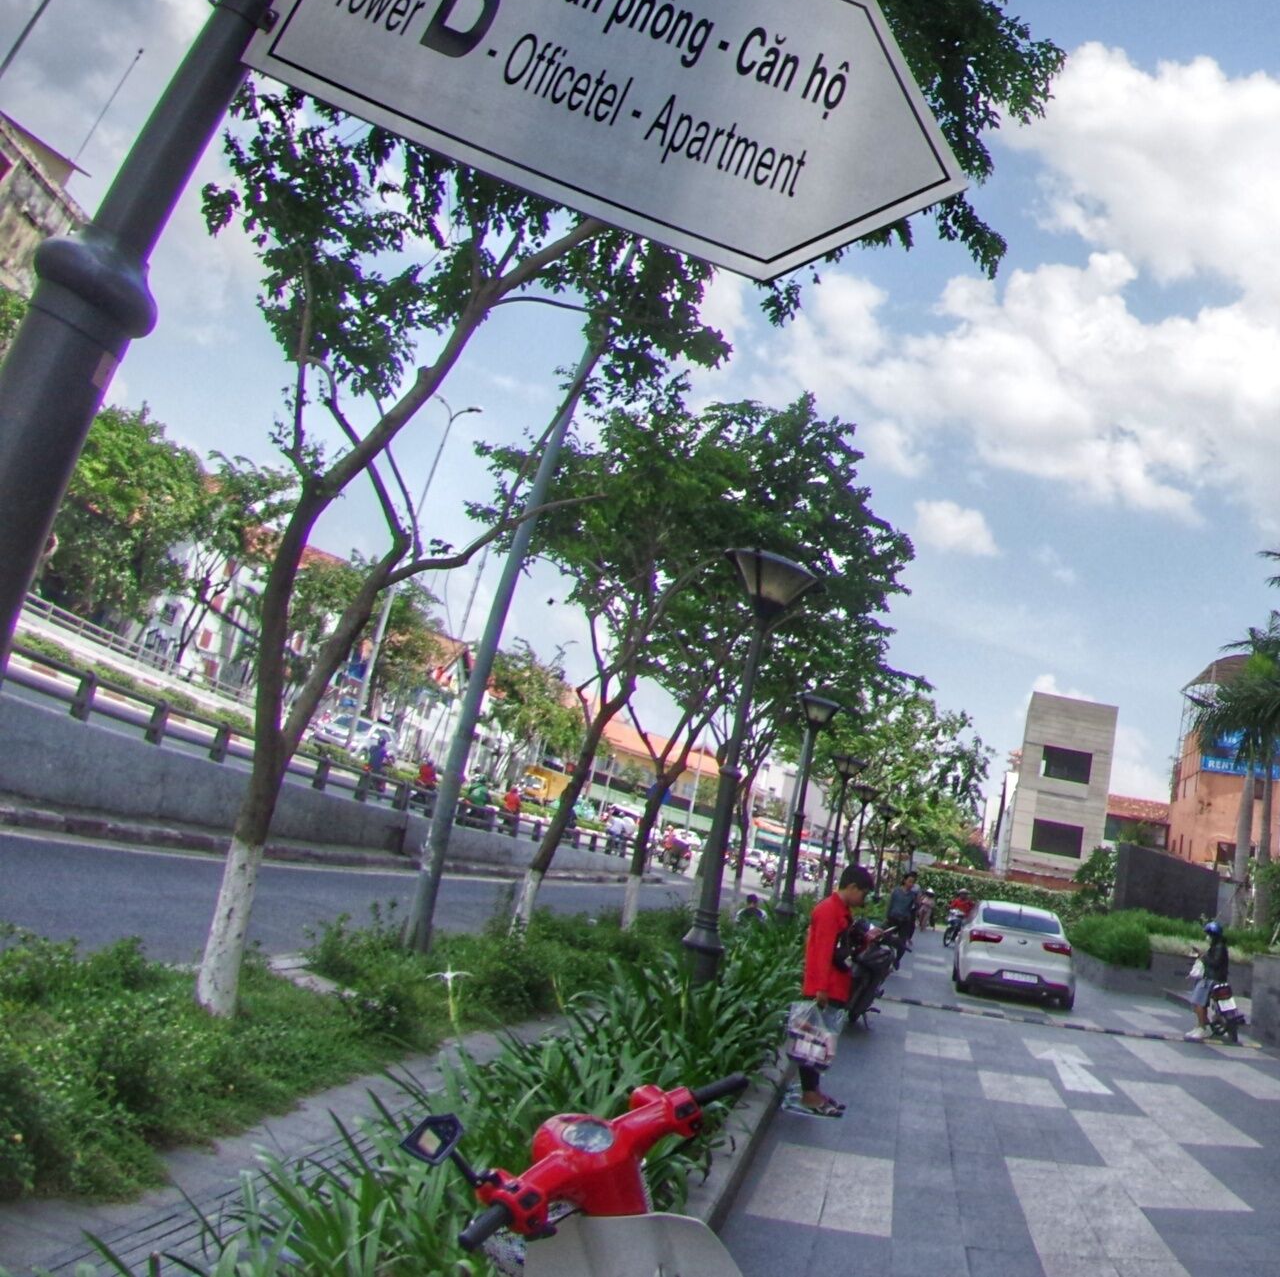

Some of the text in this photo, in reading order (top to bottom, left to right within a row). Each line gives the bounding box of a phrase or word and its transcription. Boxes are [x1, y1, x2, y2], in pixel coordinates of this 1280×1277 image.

[503, 33, 634, 126] Officetel
[643, 94, 808, 198] Apartment
[736, 27, 800, 92] Căn
[801, 53, 850, 120] hộ
